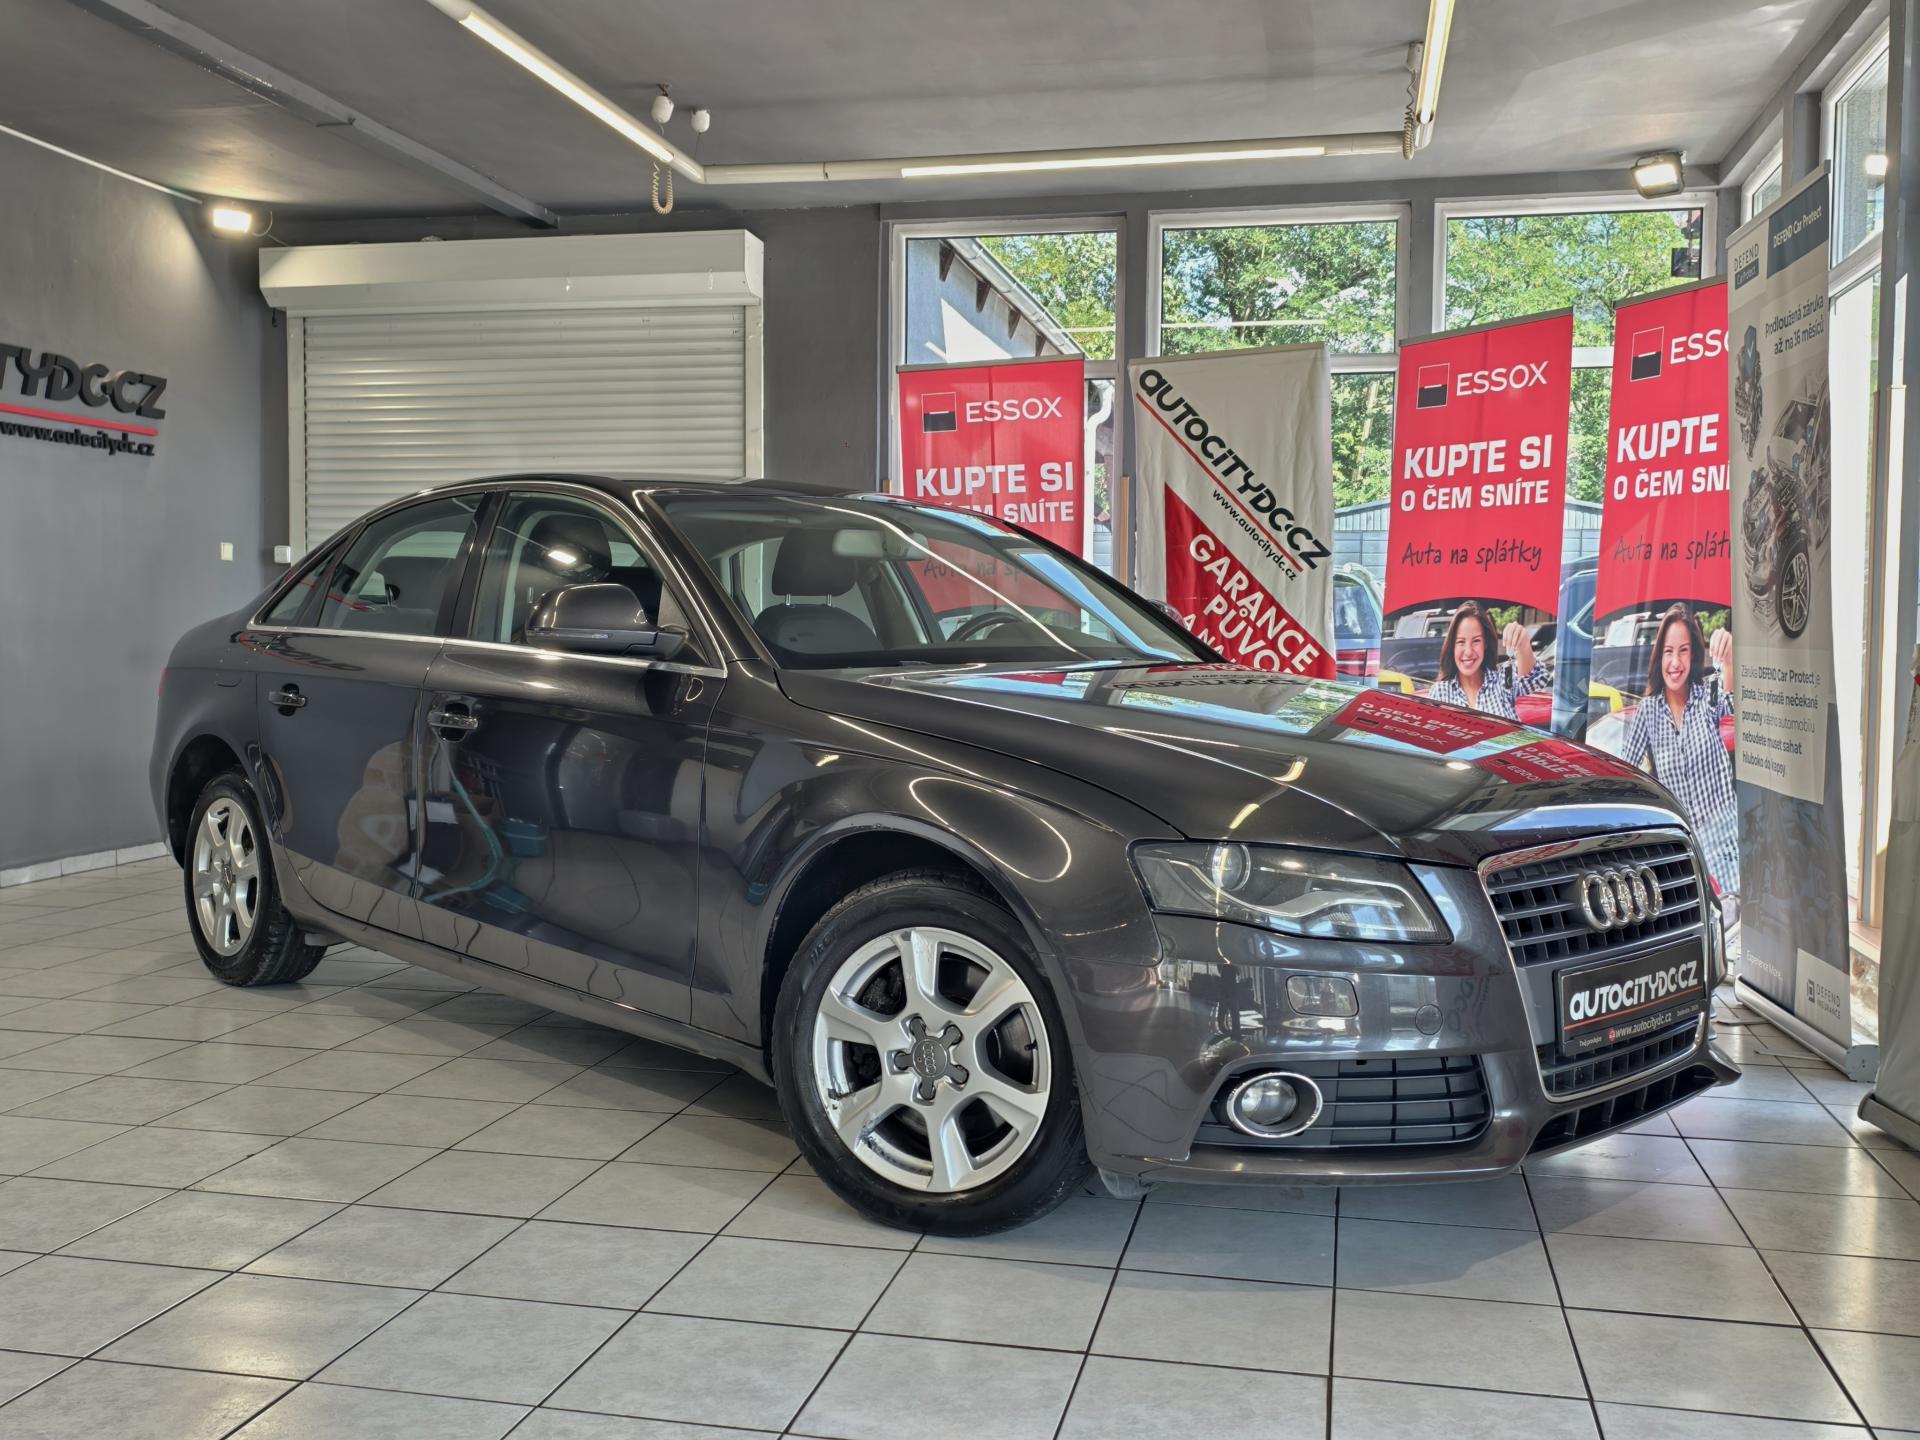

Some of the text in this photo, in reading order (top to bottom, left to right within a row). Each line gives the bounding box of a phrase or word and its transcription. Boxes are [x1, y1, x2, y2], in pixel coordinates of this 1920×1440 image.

[1773, 225, 1793, 248] DEFEND
[1734, 243, 1760, 272] DEFEND
[1670, 328, 1729, 364] ESS
[1785, 337, 1793, 351] na
[1456, 360, 1549, 397] ESSOX
[965, 396, 1063, 424] ESSOX
[1616, 413, 1720, 463] KUPTE
[1404, 434, 1552, 480] KUPTE SI
[915, 461, 1073, 498] KUPTE SI
[1613, 475, 1628, 500] O
[1634, 468, 1683, 498] ČEM
[1401, 477, 1549, 513] O ČEM SNÍTE
[1003, 498, 1074, 523] SNÍTE
[1212, 489, 1298, 582] www.autocitydc.cz
[1614, 535, 1653, 561] Auta
[1659, 544, 1678, 561] na
[1402, 538, 1543, 571] Auta na splátky
[1189, 533, 1320, 673] GARANCE
[1202, 593, 1293, 673] PŮVO
[1777, 668, 1788, 683] Car
[1789, 669, 1815, 685] Protect
[1785, 693, 1818, 709] nečekané
[1782, 739, 1803, 755] sahat
[1816, 983, 1841, 1008] DEFEND
[1616, 1012, 1672, 1038] www.autocitydc.cz
